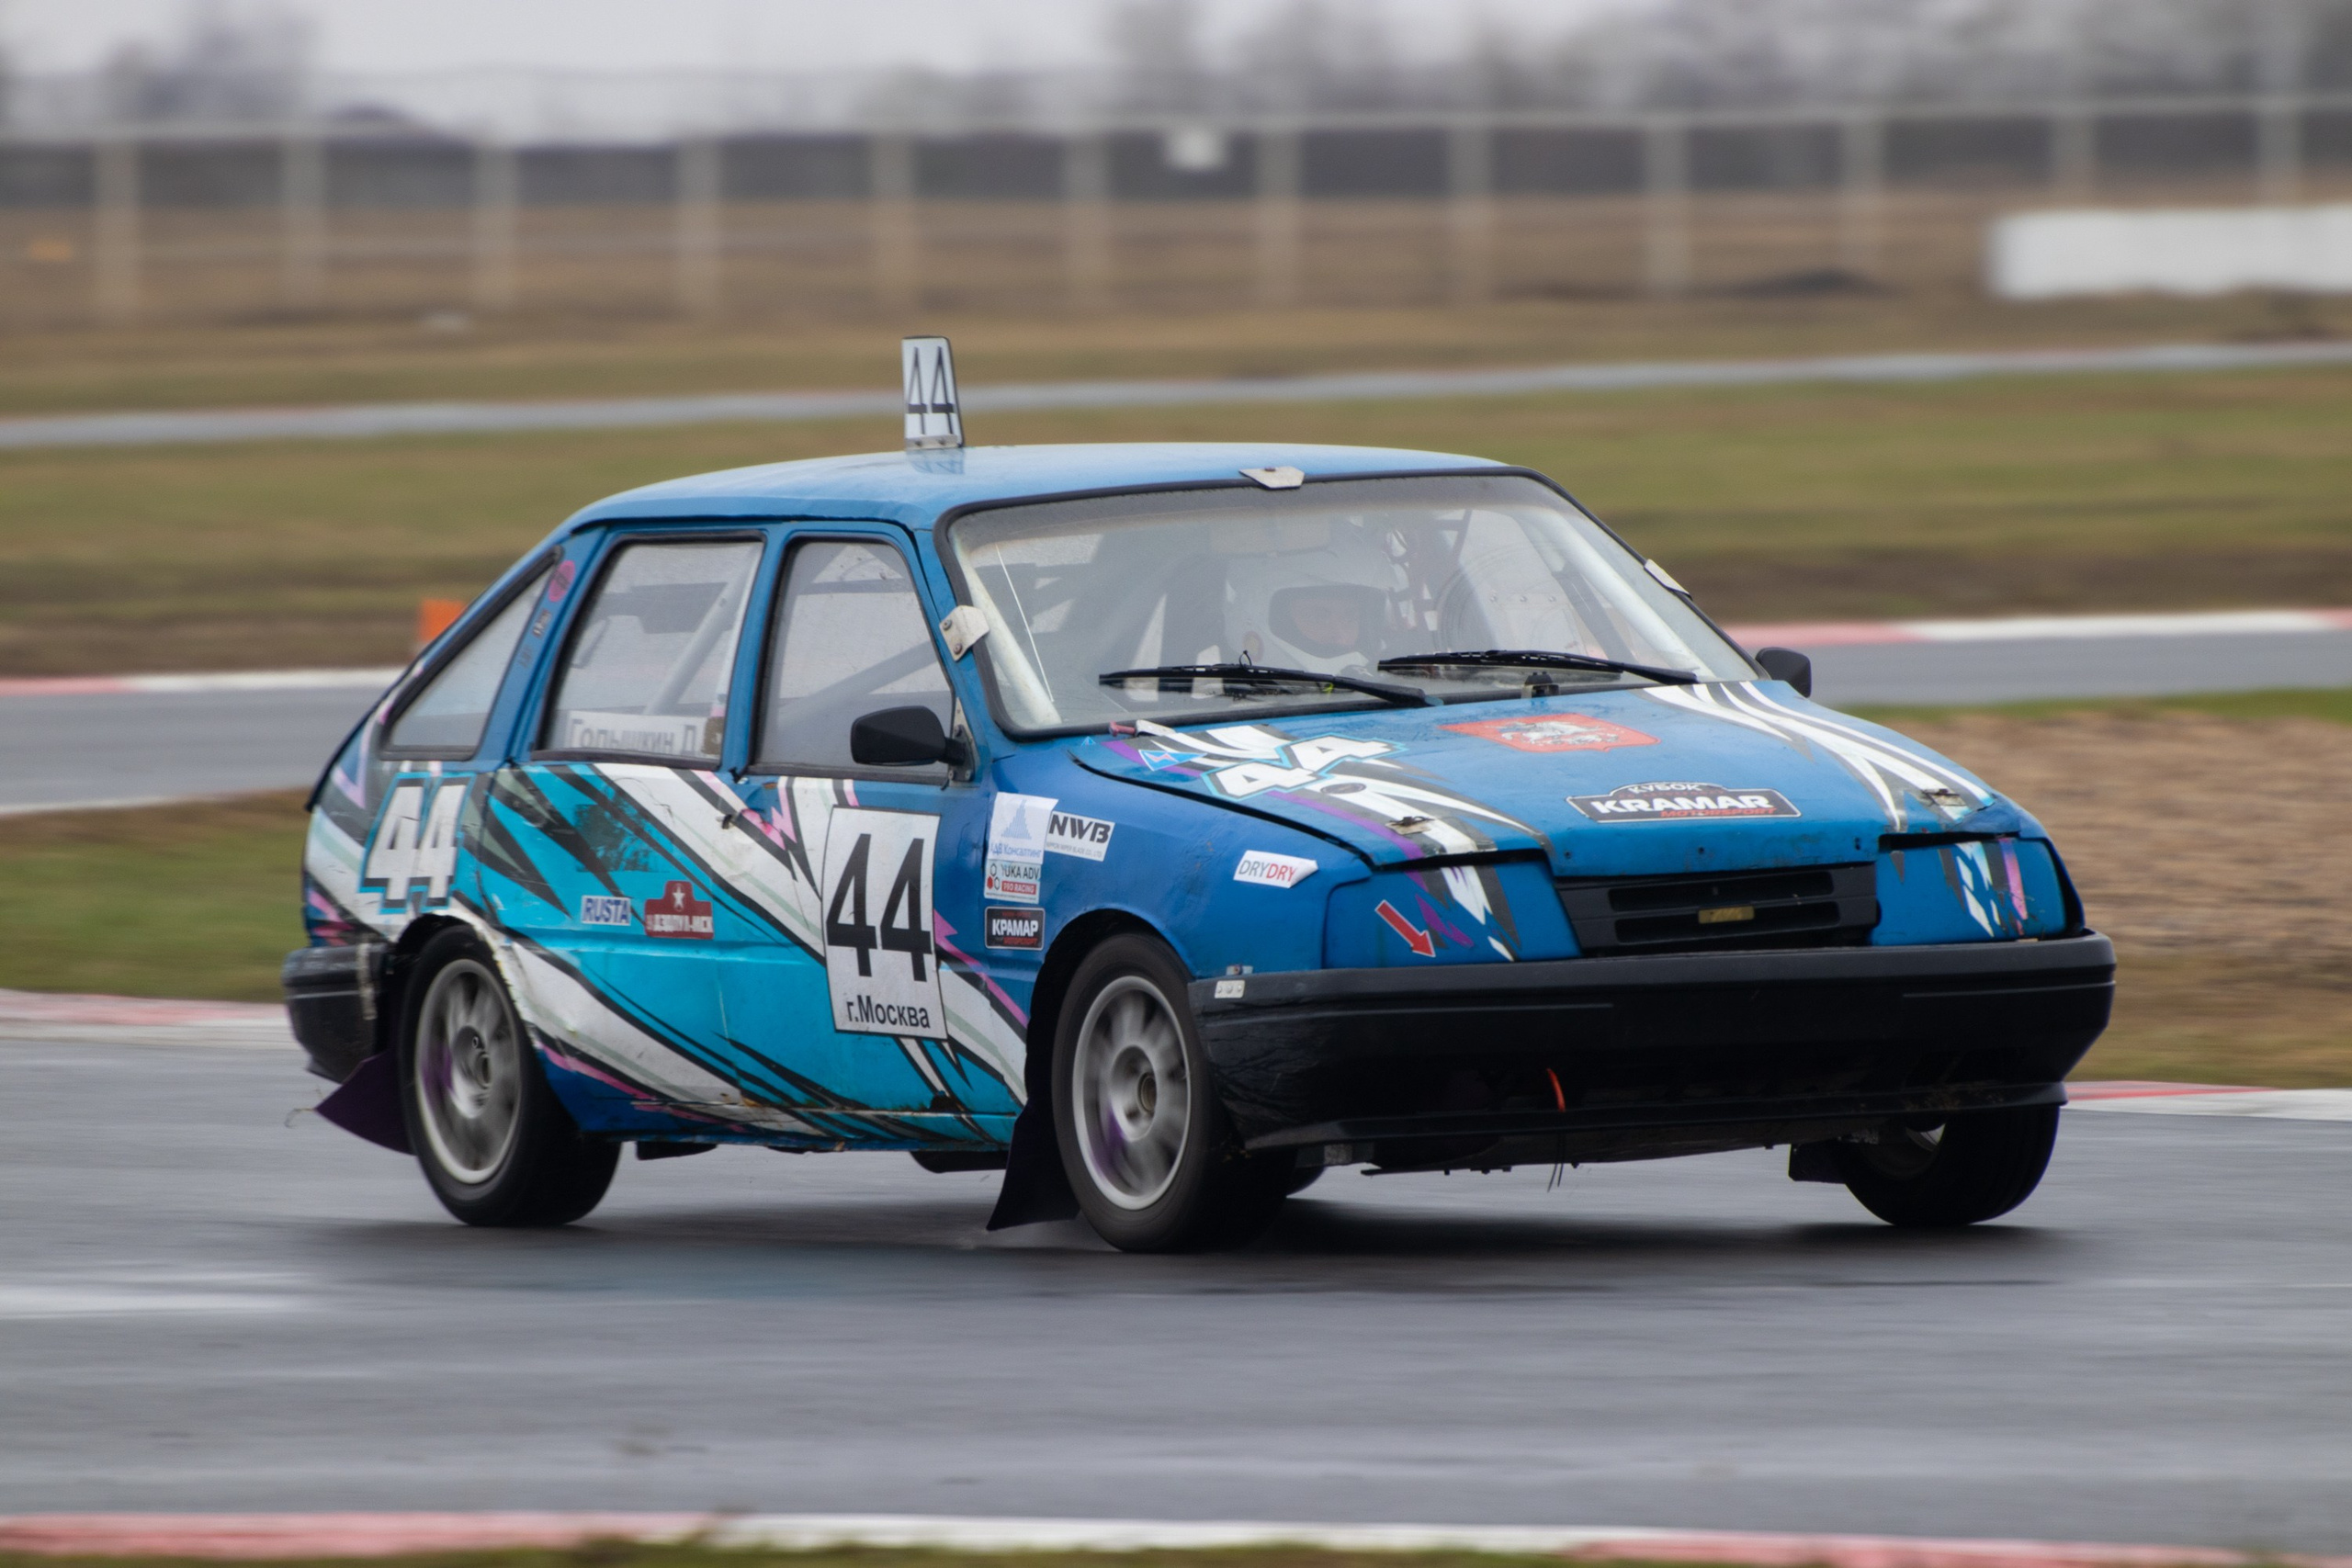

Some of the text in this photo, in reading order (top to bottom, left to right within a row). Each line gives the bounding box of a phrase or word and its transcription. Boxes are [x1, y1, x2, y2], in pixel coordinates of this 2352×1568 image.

[906, 345, 955, 435] 44
[1205, 733, 1402, 799] 44
[1590, 794, 1775, 814] KRAMAR
[1659, 807, 1778, 818] MOTORSPORT
[1048, 814, 1111, 843] NWB
[362, 777, 472, 908] 44
[1001, 864, 1022, 879] YUKA
[1238, 860, 1296, 882] DRYDRY
[1014, 883, 1035, 893] RACING
[583, 897, 629, 924] RUSTA
[826, 832, 933, 983] 44
[992, 919, 1038, 937] КРАМАР
[846, 994, 931, 1029] г.Москва
